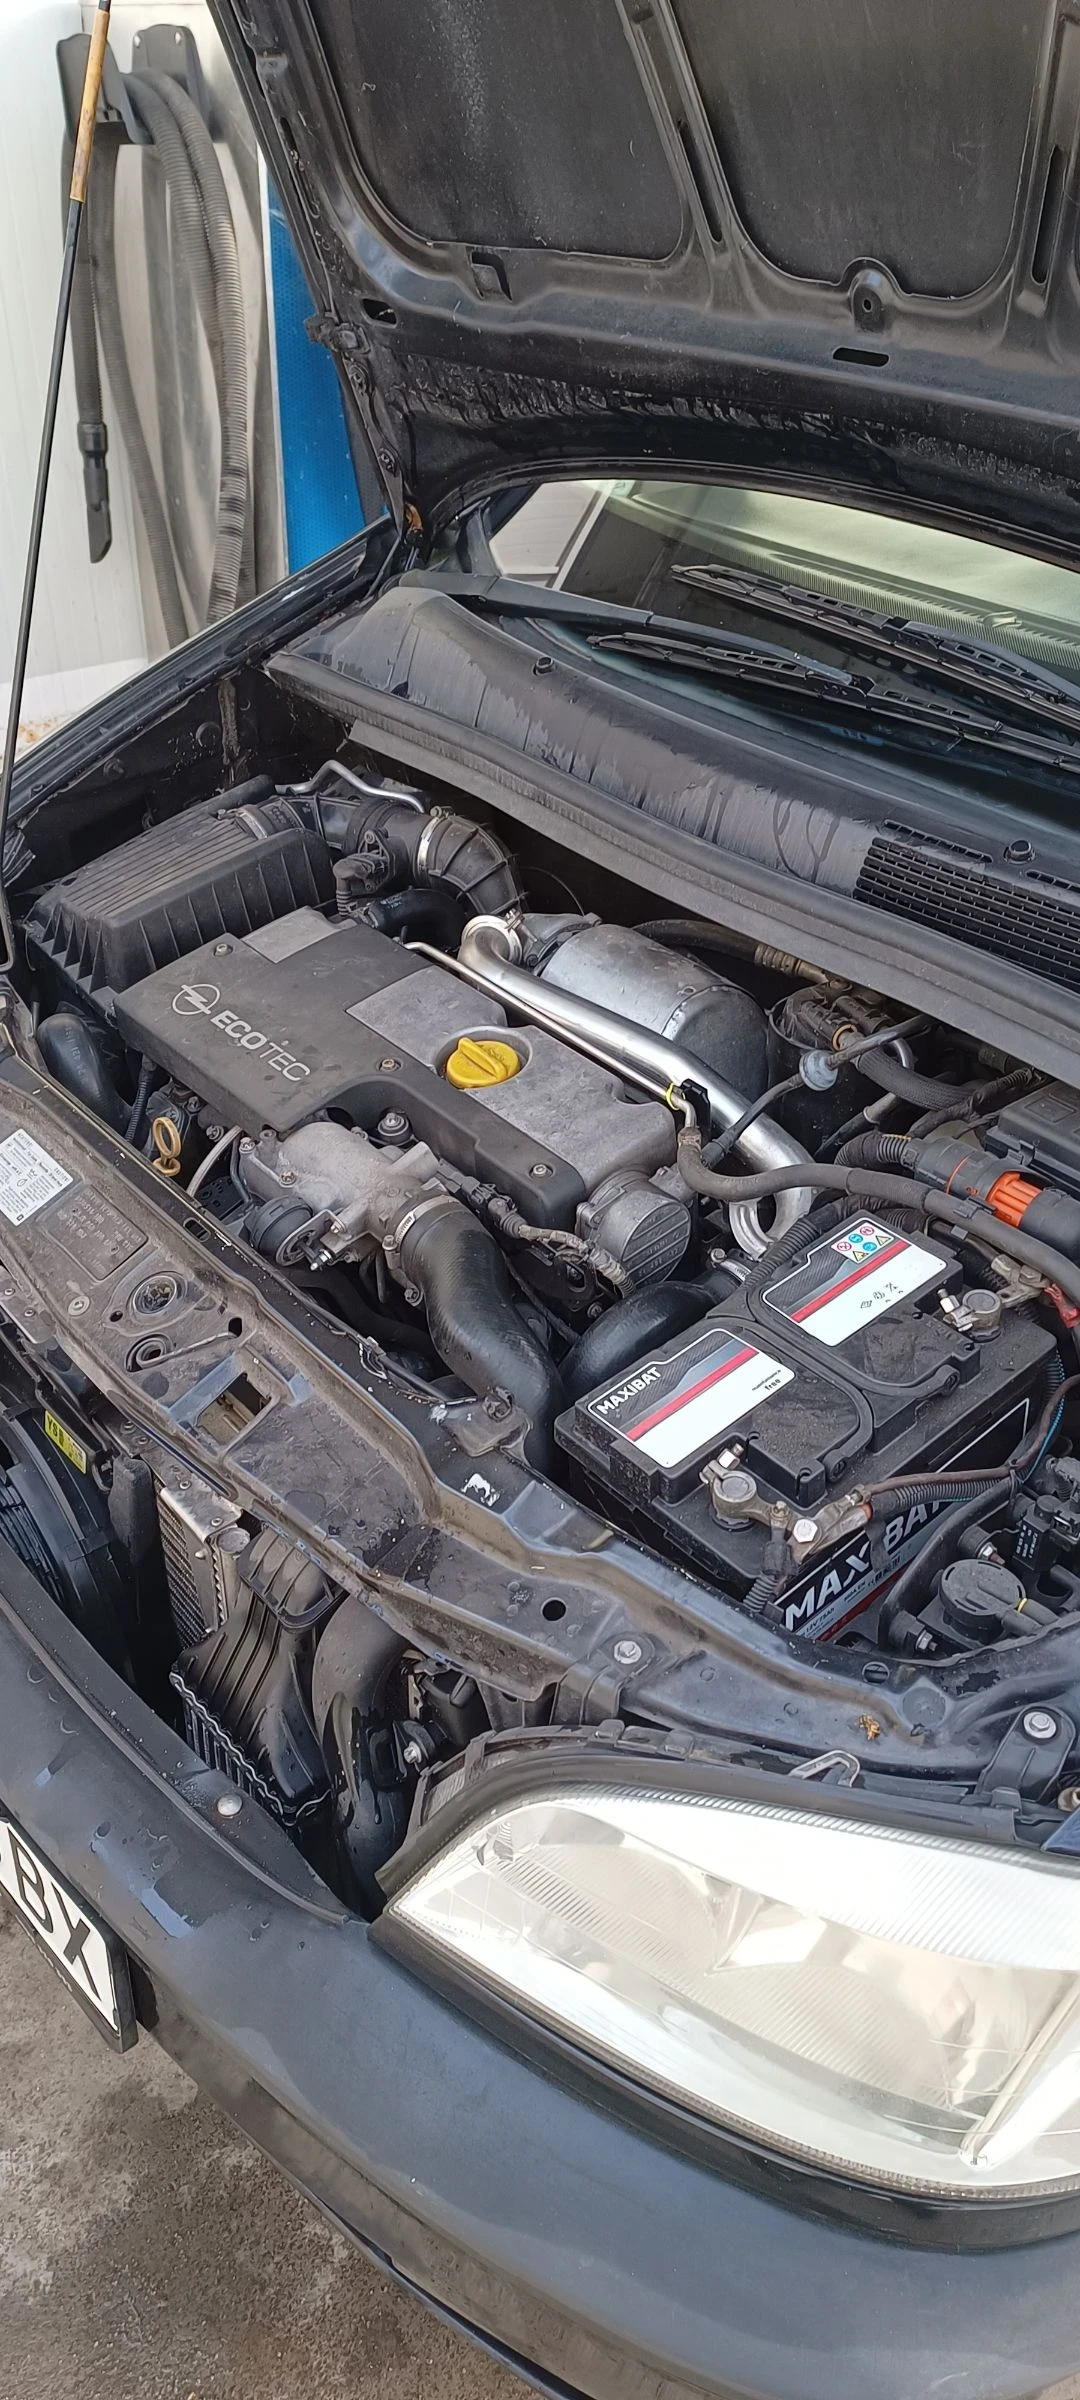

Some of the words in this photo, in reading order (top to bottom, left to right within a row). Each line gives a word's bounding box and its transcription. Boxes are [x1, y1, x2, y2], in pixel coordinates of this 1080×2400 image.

[210, 1009, 311, 1081] ECOTEC
[596, 1366, 662, 1415] MAXIBAT
[785, 1500, 940, 1632] MAXBA
[7, 1826, 102, 2001] BX
